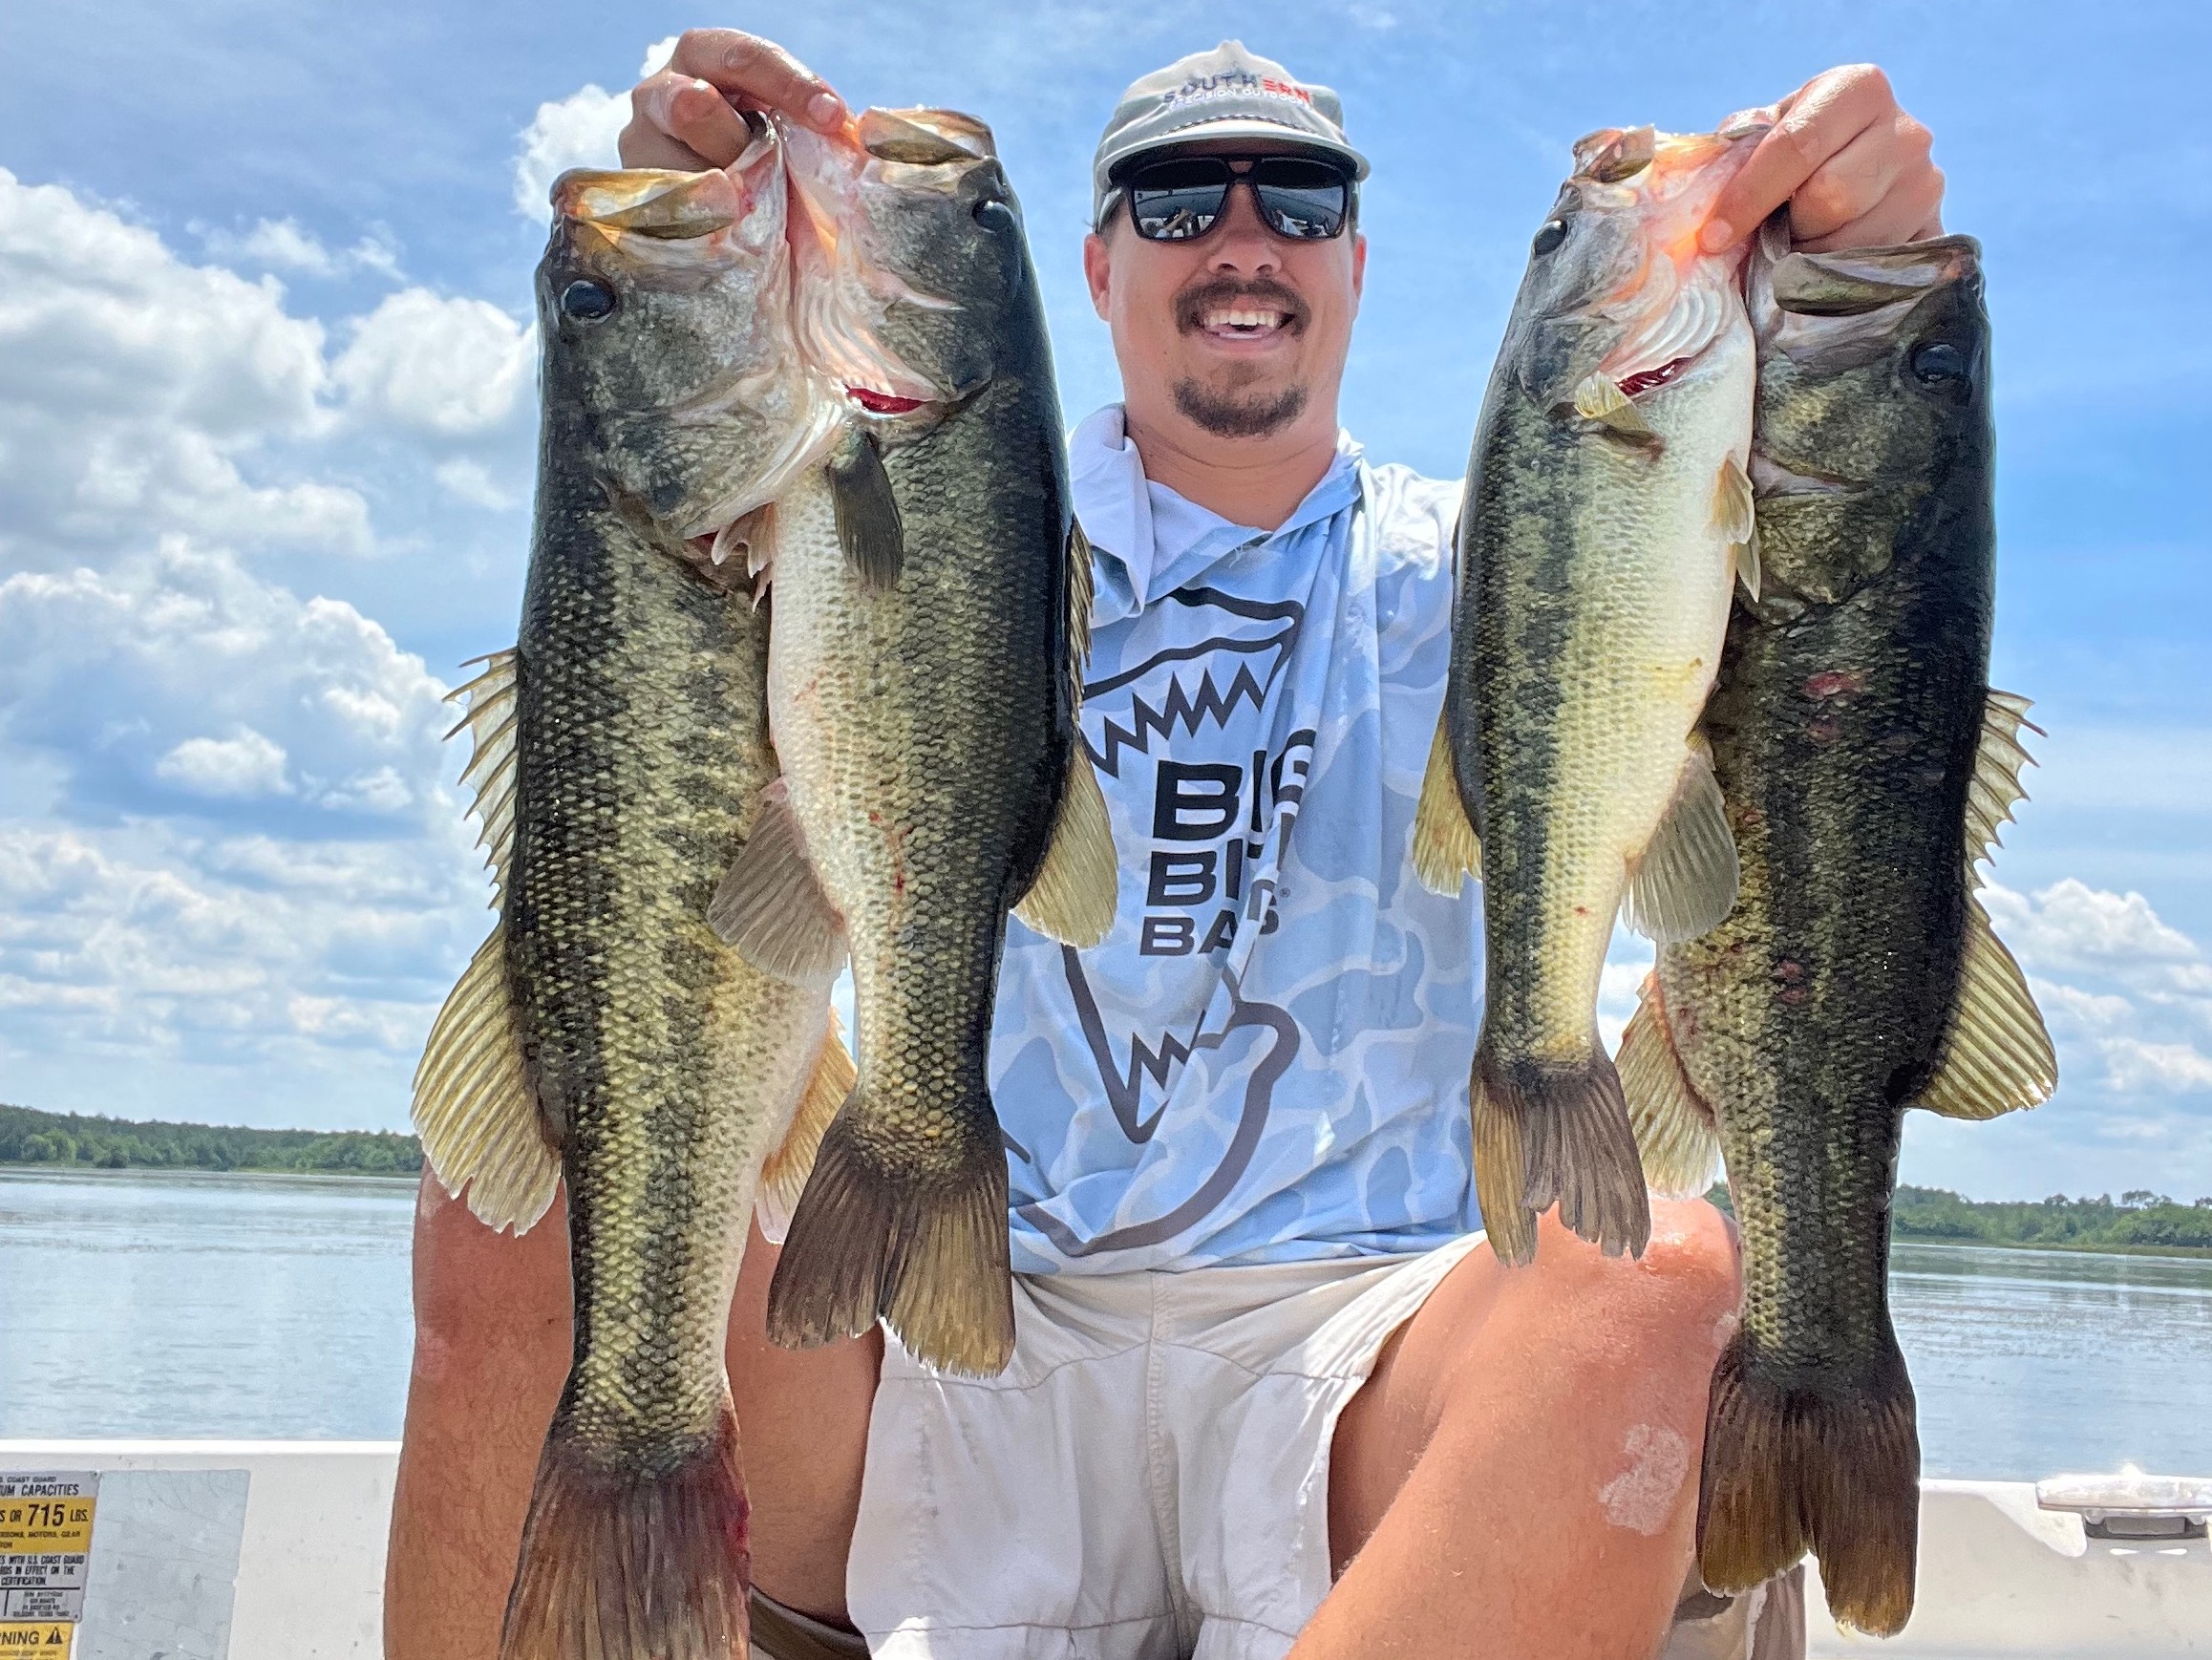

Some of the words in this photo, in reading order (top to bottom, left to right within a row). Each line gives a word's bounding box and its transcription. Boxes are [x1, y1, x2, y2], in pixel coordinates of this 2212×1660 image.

[1164, 73, 1311, 103] SOUTHERN
[21, 1483, 79, 1497] CAPACITIES
[10, 1509, 22, 1522] OR
[28, 1502, 65, 1526] 715
